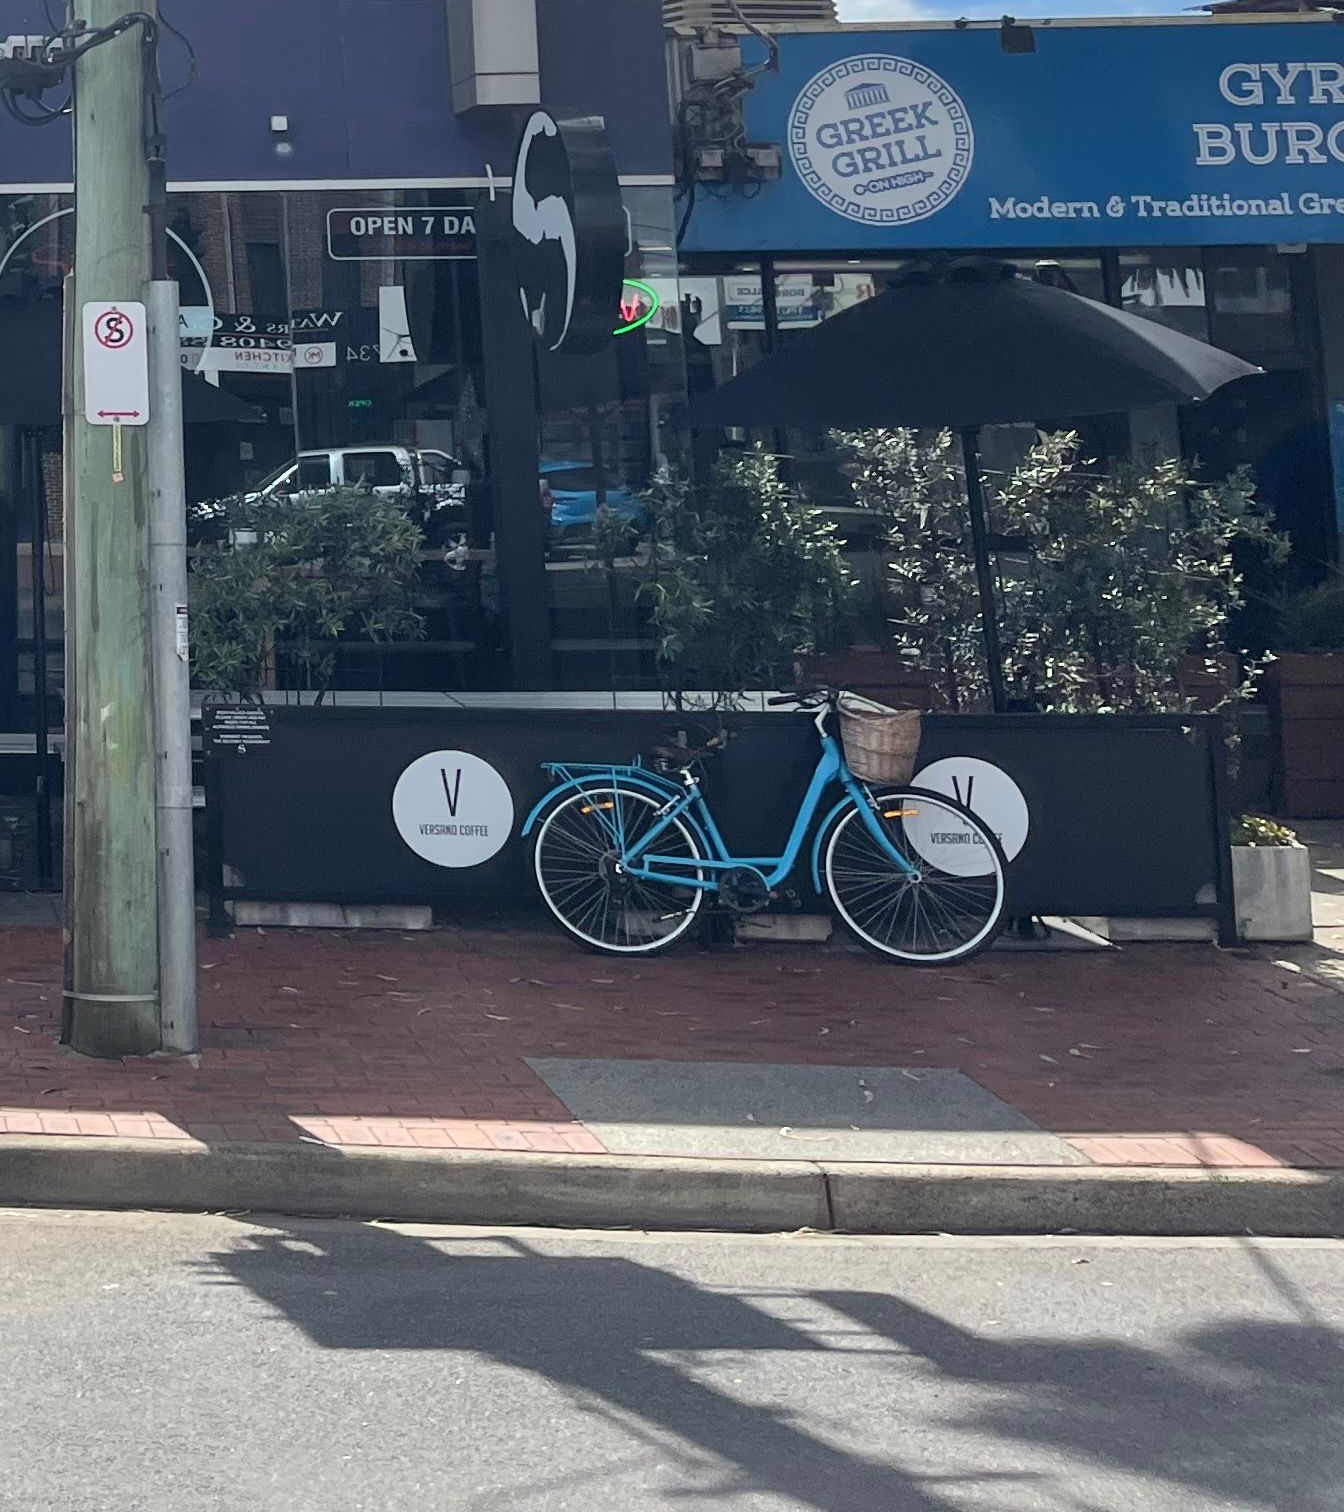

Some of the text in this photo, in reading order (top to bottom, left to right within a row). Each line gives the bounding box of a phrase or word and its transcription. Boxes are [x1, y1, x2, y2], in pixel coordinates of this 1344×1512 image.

[816, 101, 939, 149] GREEK
[832, 135, 942, 178] GRILL
[870, 171, 924, 193] ON HIGH
[988, 196, 1101, 219] Modern
[1106, 195, 1126, 218] &
[1131, 193, 1294, 218] Traditional
[350, 216, 413, 236] OPEN
[421, 217, 434, 235] 7
[419, 823, 489, 837] VERSANO COFFEE
